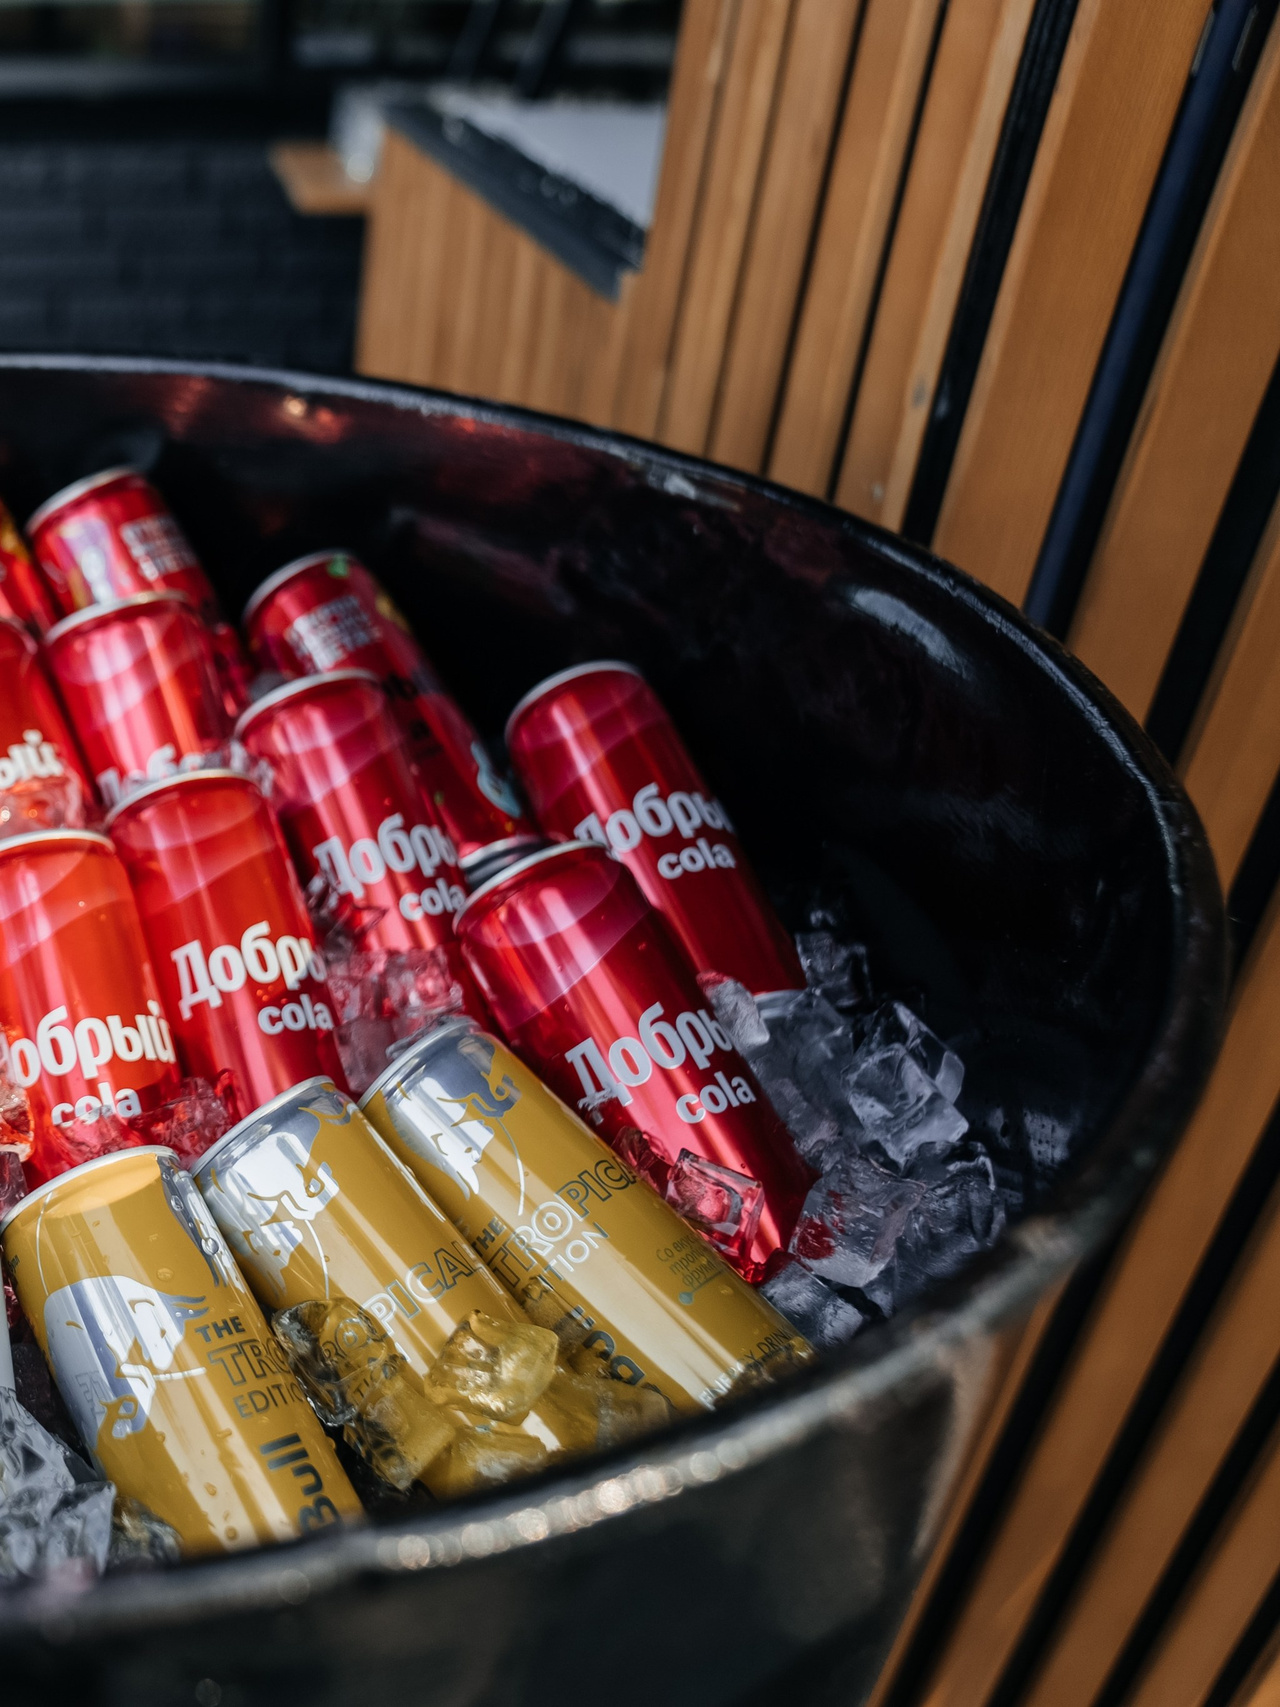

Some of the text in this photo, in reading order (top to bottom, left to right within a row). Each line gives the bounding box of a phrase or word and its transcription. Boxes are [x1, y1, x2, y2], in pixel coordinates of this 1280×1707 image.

[657, 838, 736, 880] cola
[399, 868, 467, 911] cola
[257, 994, 335, 1035] cola
[675, 1071, 757, 1124] cola
[195, 1316, 246, 1343] THE
